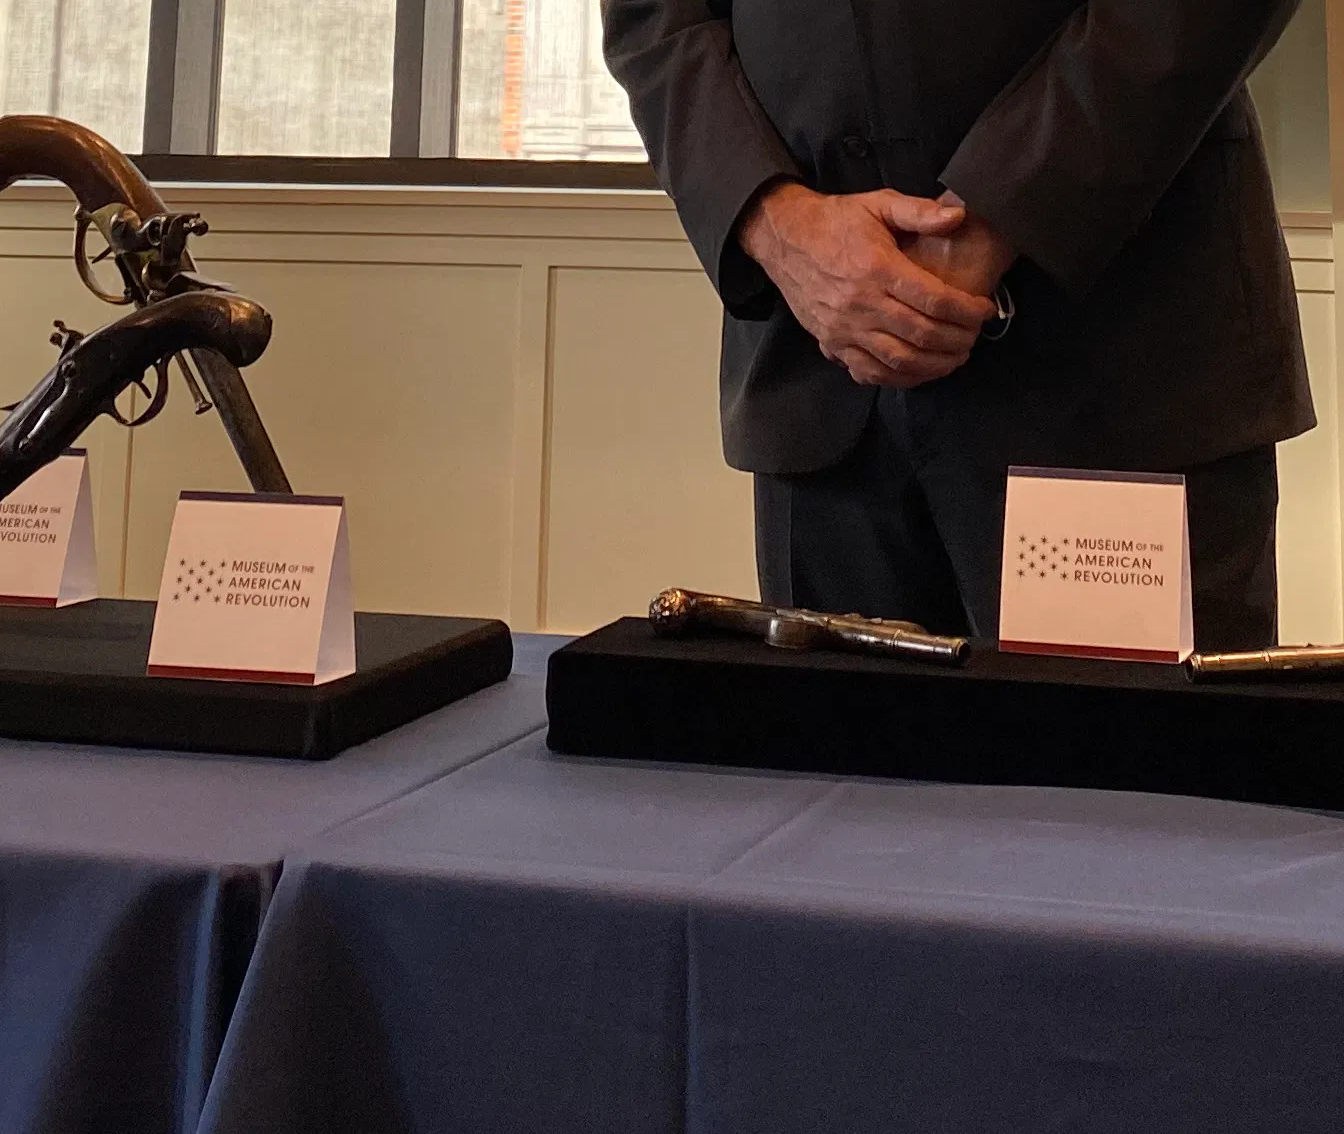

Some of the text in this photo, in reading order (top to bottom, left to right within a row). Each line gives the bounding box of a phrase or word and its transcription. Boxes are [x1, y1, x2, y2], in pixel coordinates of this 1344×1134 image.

[1075, 537, 1164, 552] MUSEUM OF THE
[231, 560, 315, 574] MUSEUM OF THE
[1074, 553, 1152, 570] AMERICAN
[228, 576, 302, 591] AMERICAN
[1073, 569, 1164, 587] REVOLUTION
[225, 593, 311, 609] REVOLUTION
